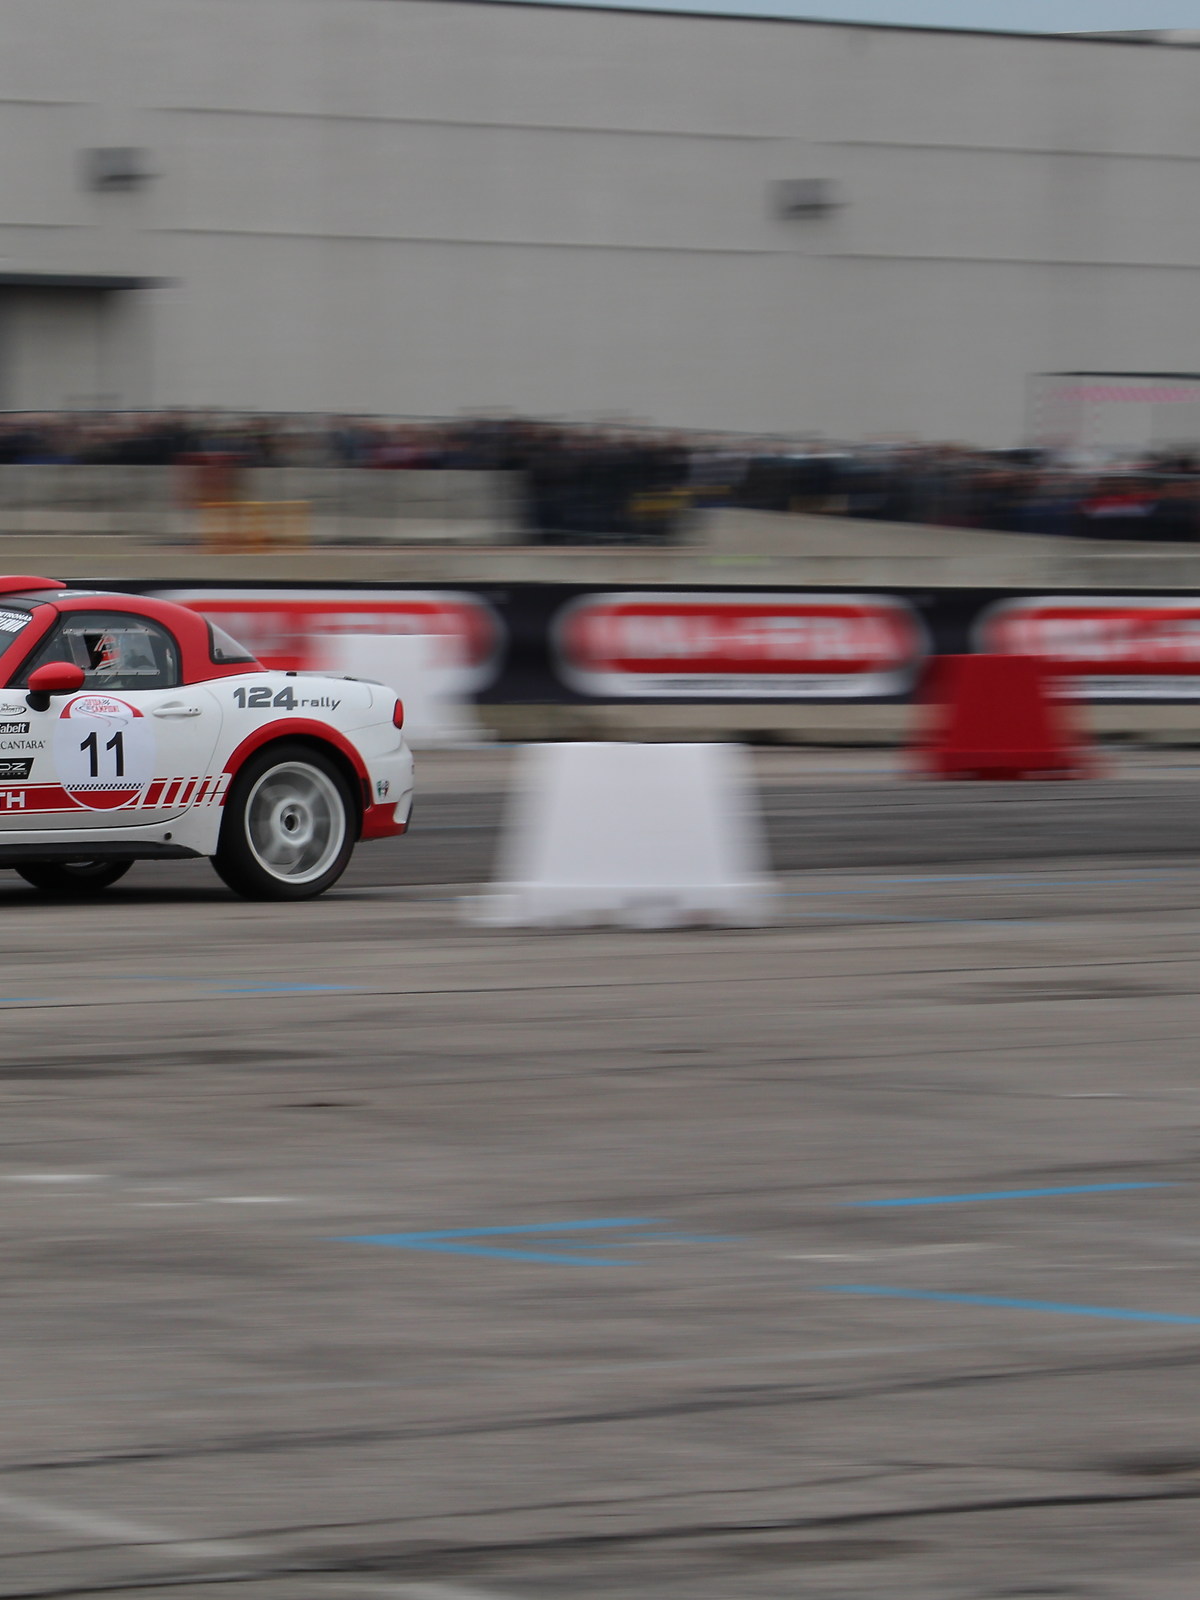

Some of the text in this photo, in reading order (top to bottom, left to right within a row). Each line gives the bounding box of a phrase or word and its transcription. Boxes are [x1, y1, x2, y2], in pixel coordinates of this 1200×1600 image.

[233, 686, 341, 711] 124 rally
[80, 731, 124, 777] 11
